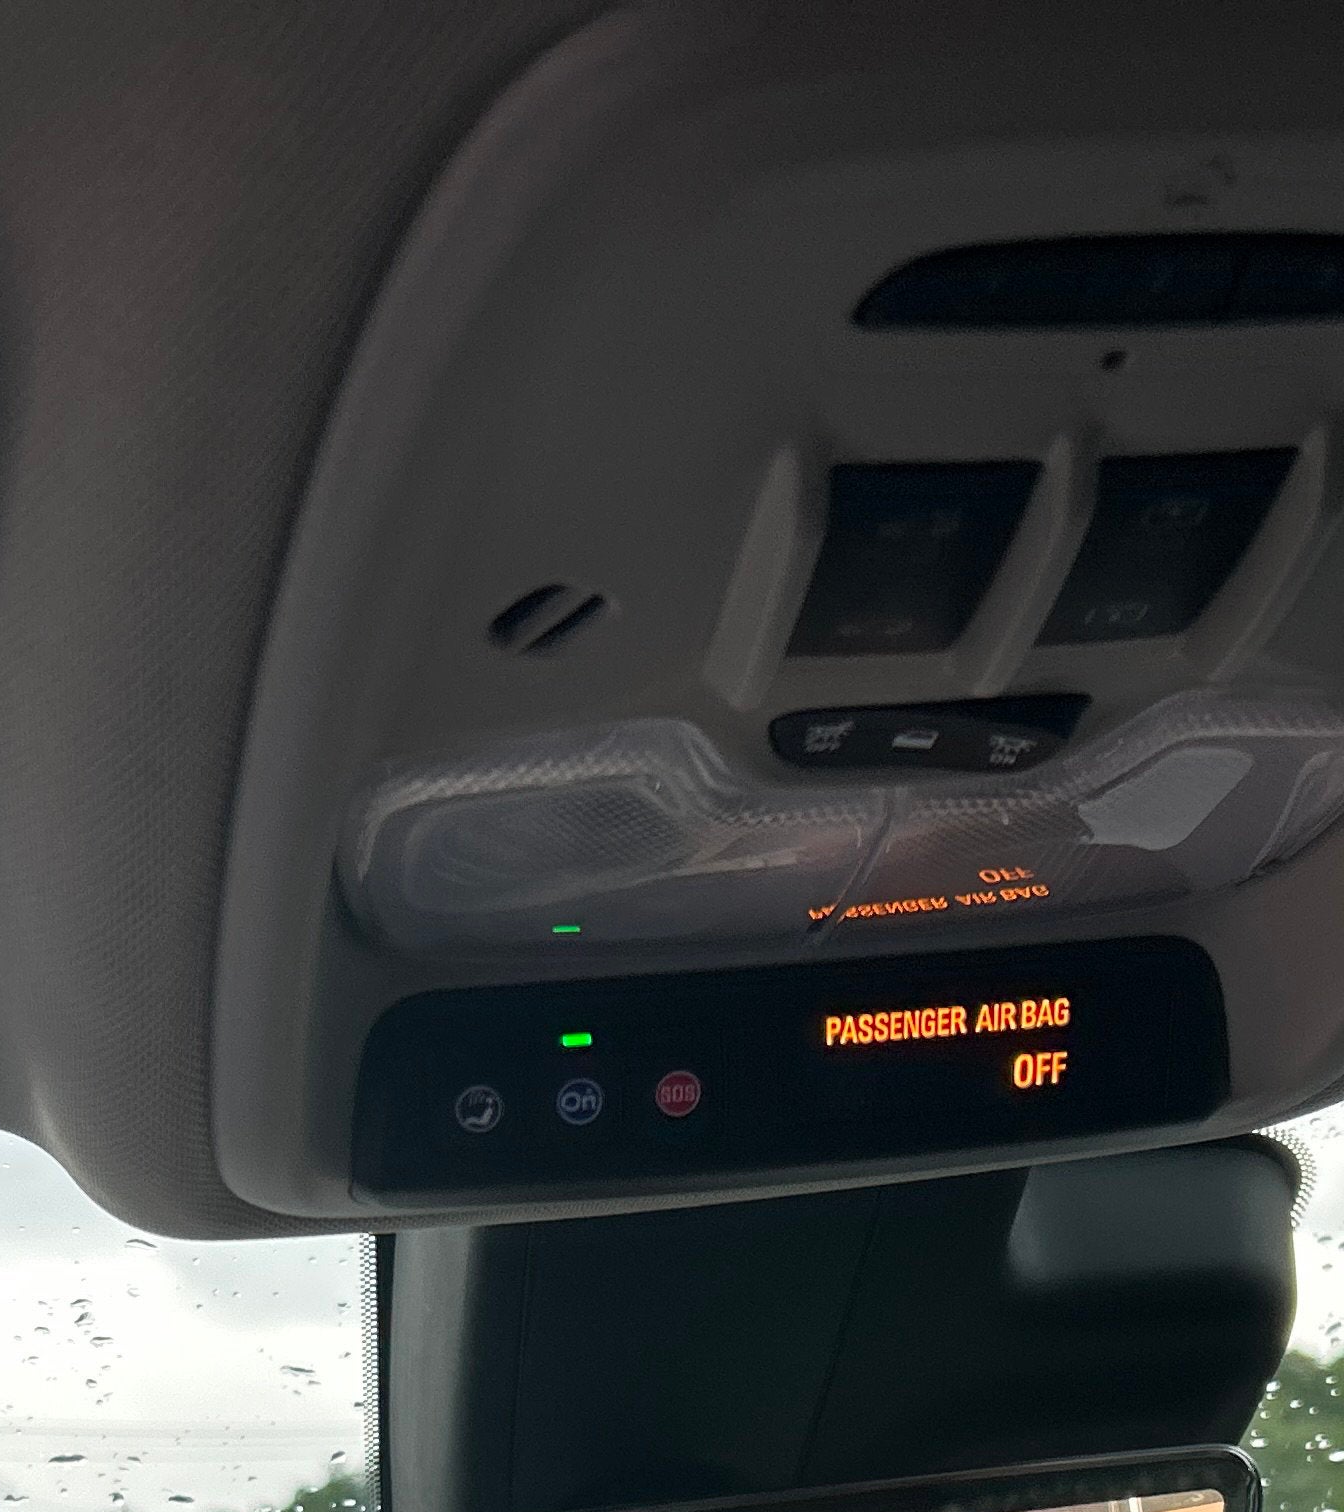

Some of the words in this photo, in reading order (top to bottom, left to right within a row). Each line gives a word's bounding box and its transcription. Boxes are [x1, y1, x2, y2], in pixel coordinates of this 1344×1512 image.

[825, 1005, 967, 1046] PASSENGER
[975, 1002, 1017, 1036] AIR
[1020, 997, 1071, 1030] BAG
[1013, 1051, 1068, 1088] OFF
[660, 1083, 696, 1104] SOS
